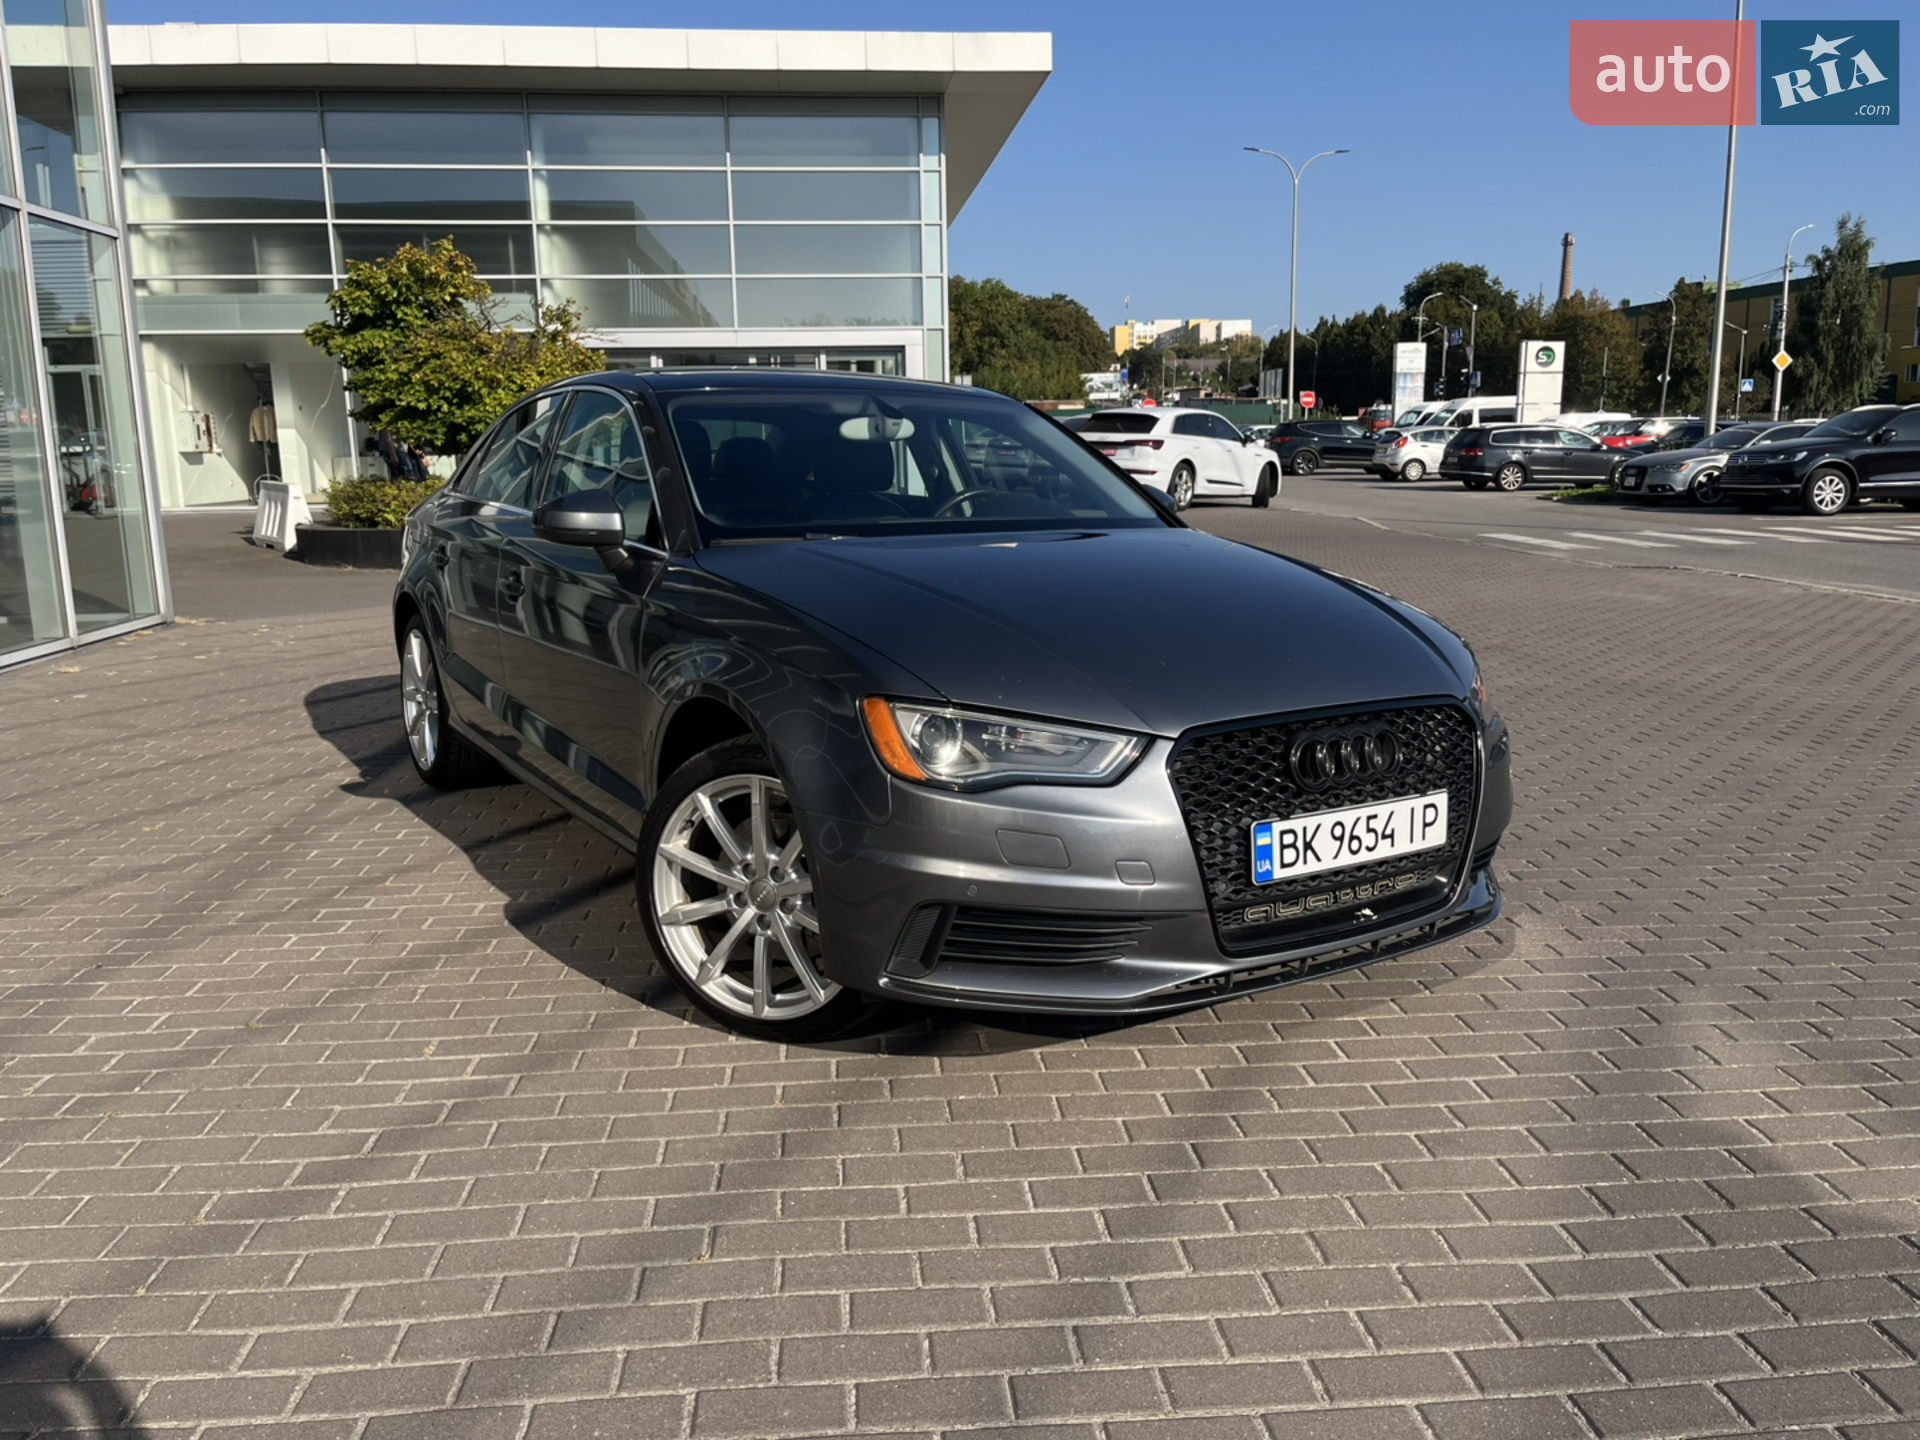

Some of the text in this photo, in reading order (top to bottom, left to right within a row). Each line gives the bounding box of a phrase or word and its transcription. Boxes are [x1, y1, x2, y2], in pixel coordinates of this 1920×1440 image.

[1279, 802, 1439, 870] BK 9654 IP
[1256, 858, 1272, 873] UA
